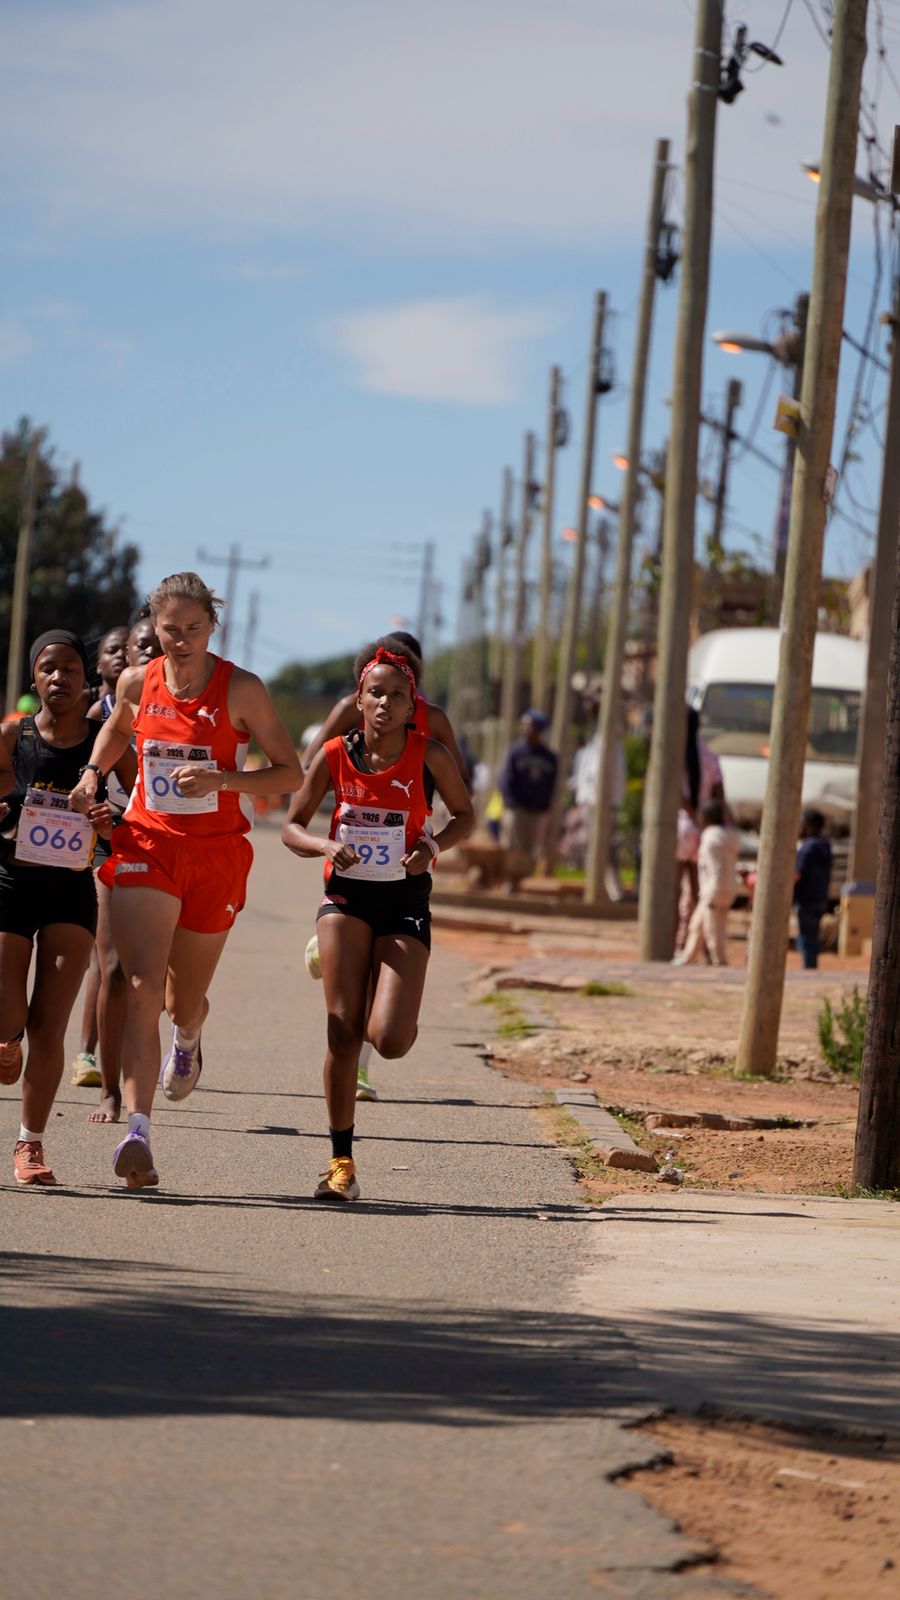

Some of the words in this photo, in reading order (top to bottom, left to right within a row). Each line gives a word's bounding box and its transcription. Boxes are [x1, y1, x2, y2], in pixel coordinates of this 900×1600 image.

[166, 748, 184, 758] 2026
[190, 750, 207, 758] ASA
[50, 797, 69, 809] 2026
[362, 812, 380, 823] 2026
[387, 814, 402, 822] ASA
[30, 826, 83, 851] 066
